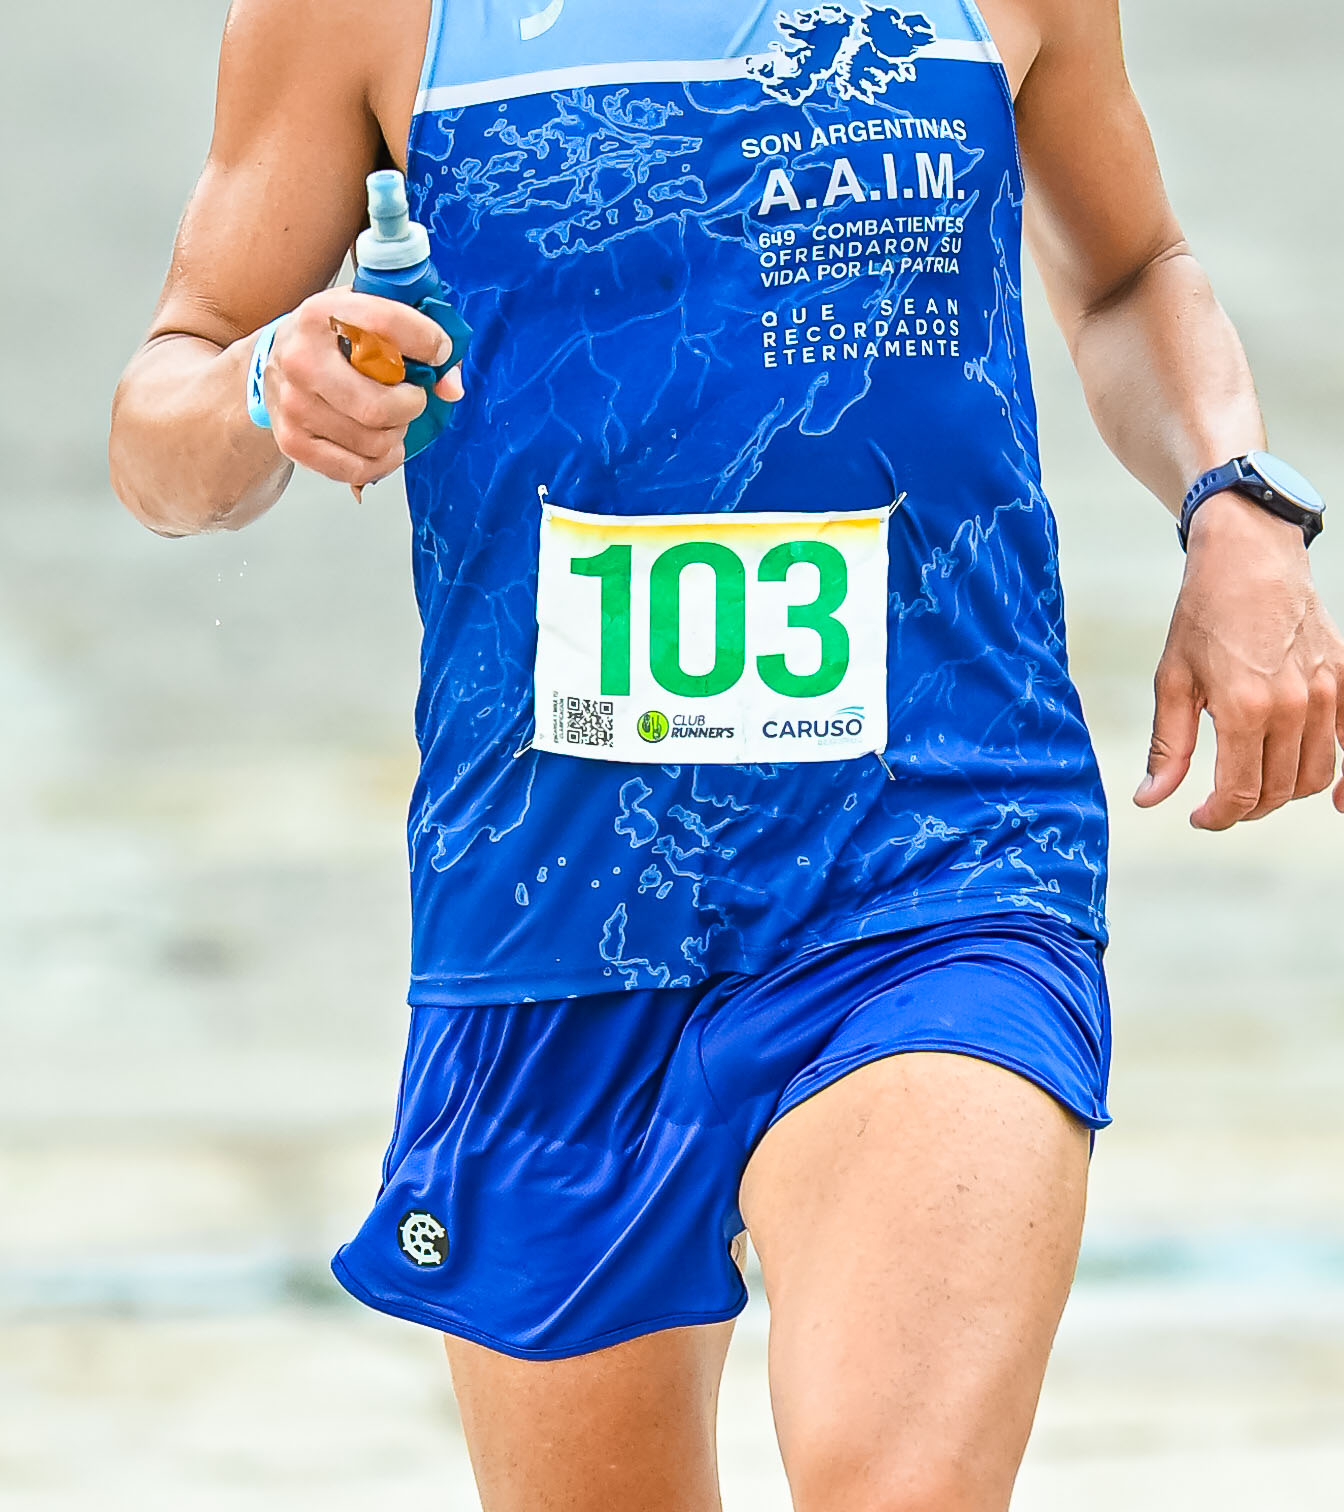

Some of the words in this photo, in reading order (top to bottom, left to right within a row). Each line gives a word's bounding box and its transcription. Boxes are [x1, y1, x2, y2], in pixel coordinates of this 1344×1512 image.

[742, 131, 802, 158] SON
[810, 118, 967, 148] ARGENTINAS
[758, 152, 965, 216] A.A.I.M.
[759, 230, 796, 248] 649
[812, 216, 964, 241] COMBATIENTES
[760, 237, 929, 268] OFRENDARON
[941, 237, 962, 254] SU
[761, 267, 810, 287] VIDA
[817, 261, 861, 280] POR
[868, 259, 894, 276] LA
[901, 257, 960, 274] PATRIA
[761, 304, 835, 327] QUE
[880, 298, 958, 316] SEAN
[763, 319, 959, 348] RECORDADOS
[764, 340, 960, 368] ETERNAMENTE
[570, 540, 850, 698] 103
[672, 714, 705, 726] CLUB
[762, 718, 863, 738] CARUSO
